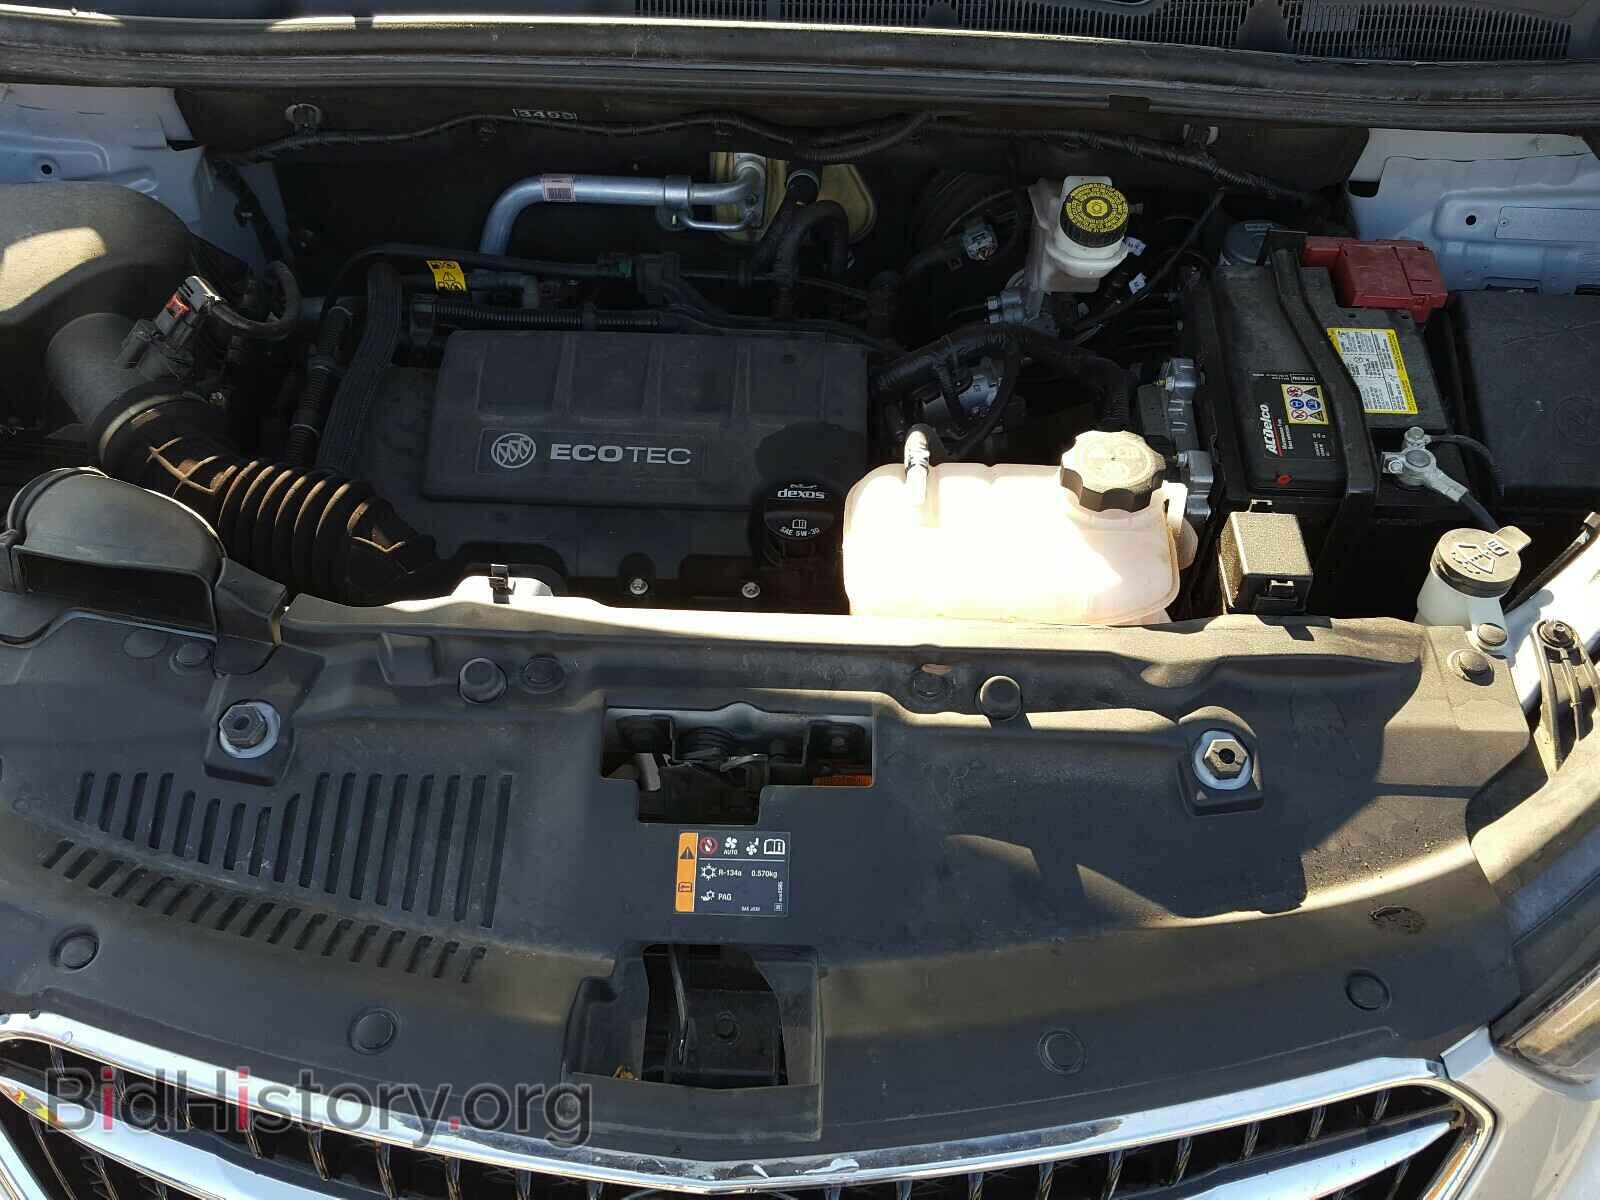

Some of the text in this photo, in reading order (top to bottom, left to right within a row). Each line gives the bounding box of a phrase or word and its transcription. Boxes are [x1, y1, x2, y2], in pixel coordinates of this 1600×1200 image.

[1259, 404, 1279, 455] ACDelco
[549, 443, 692, 465] ECOTEC
[777, 488, 825, 499] dexos
[718, 869, 778, 879] R-134a 0.570kg
[718, 893, 732, 901] PAG
